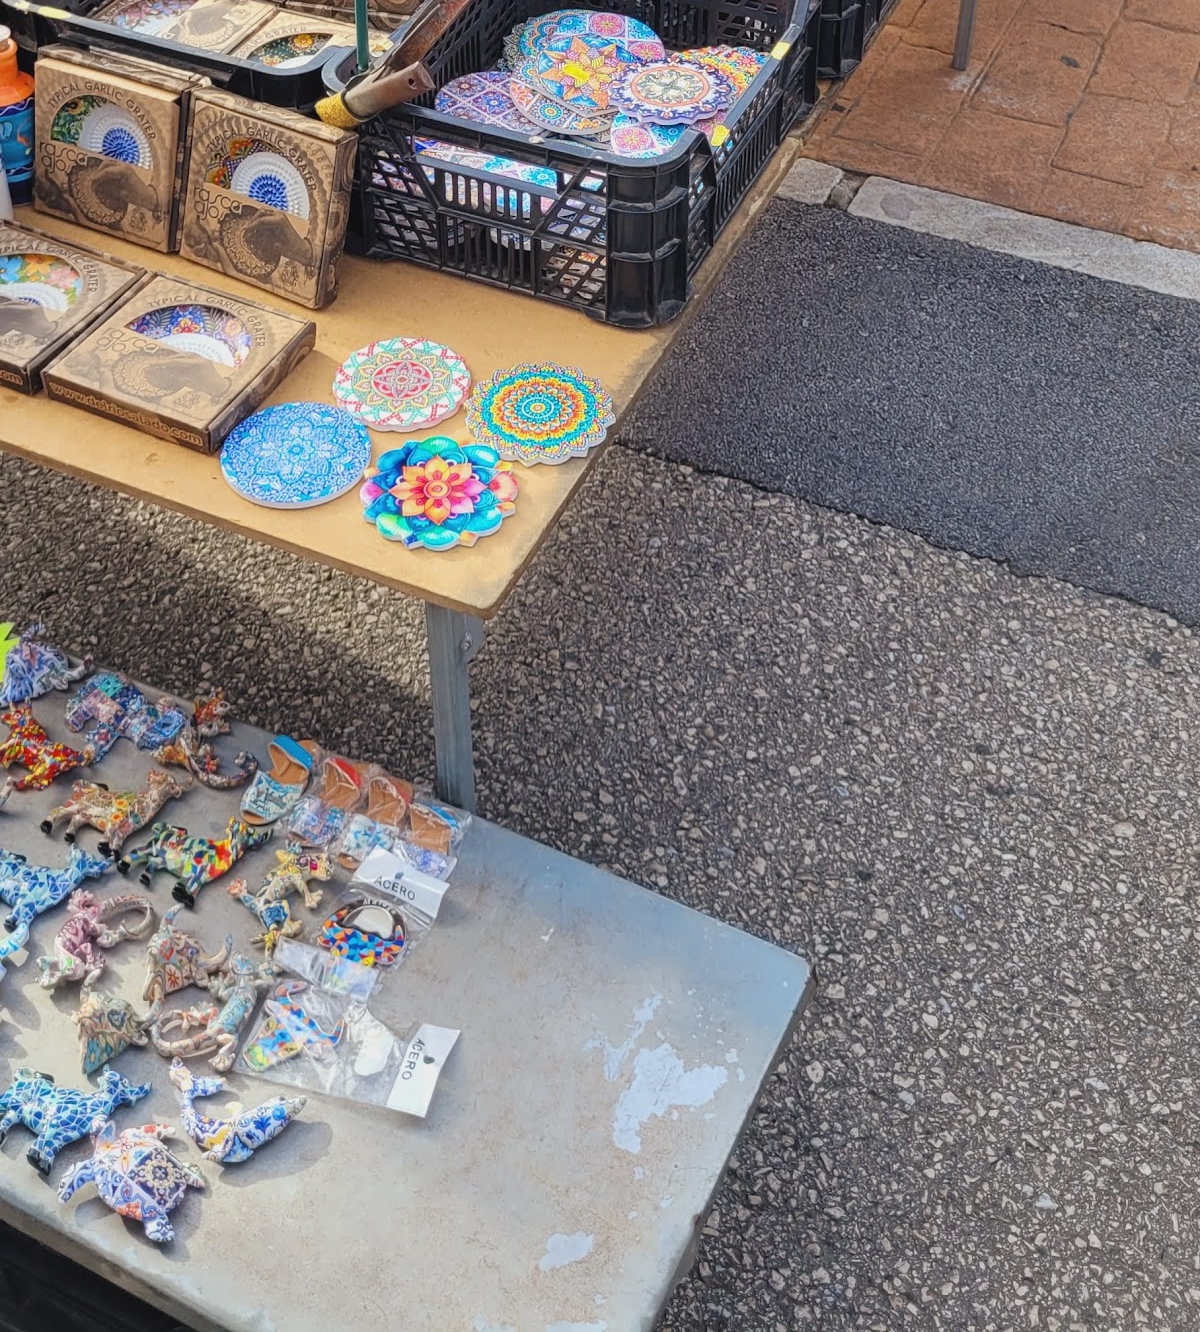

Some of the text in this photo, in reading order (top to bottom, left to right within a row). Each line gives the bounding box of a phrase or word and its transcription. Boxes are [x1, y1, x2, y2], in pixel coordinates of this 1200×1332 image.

[265, 26, 307, 39] GRATER
[48, 81, 156, 140] TYPICAL GARLIC GRATER
[39, 140, 88, 167] rasca
[206, 126, 317, 192] TYPICAL GARLIC GRATER
[194, 186, 242, 215] rasca
[46, 245, 86, 264] GARLIC
[83, 262, 101, 293] GRATER
[102, 327, 160, 354] rasca
[147, 294, 266, 348] TYPICAL GARLIC GRATER
[49, 382, 203, 446] www.delriosalado.com
[374, 875, 416, 901] ACERO
[401, 1037, 426, 1081] ACERO
